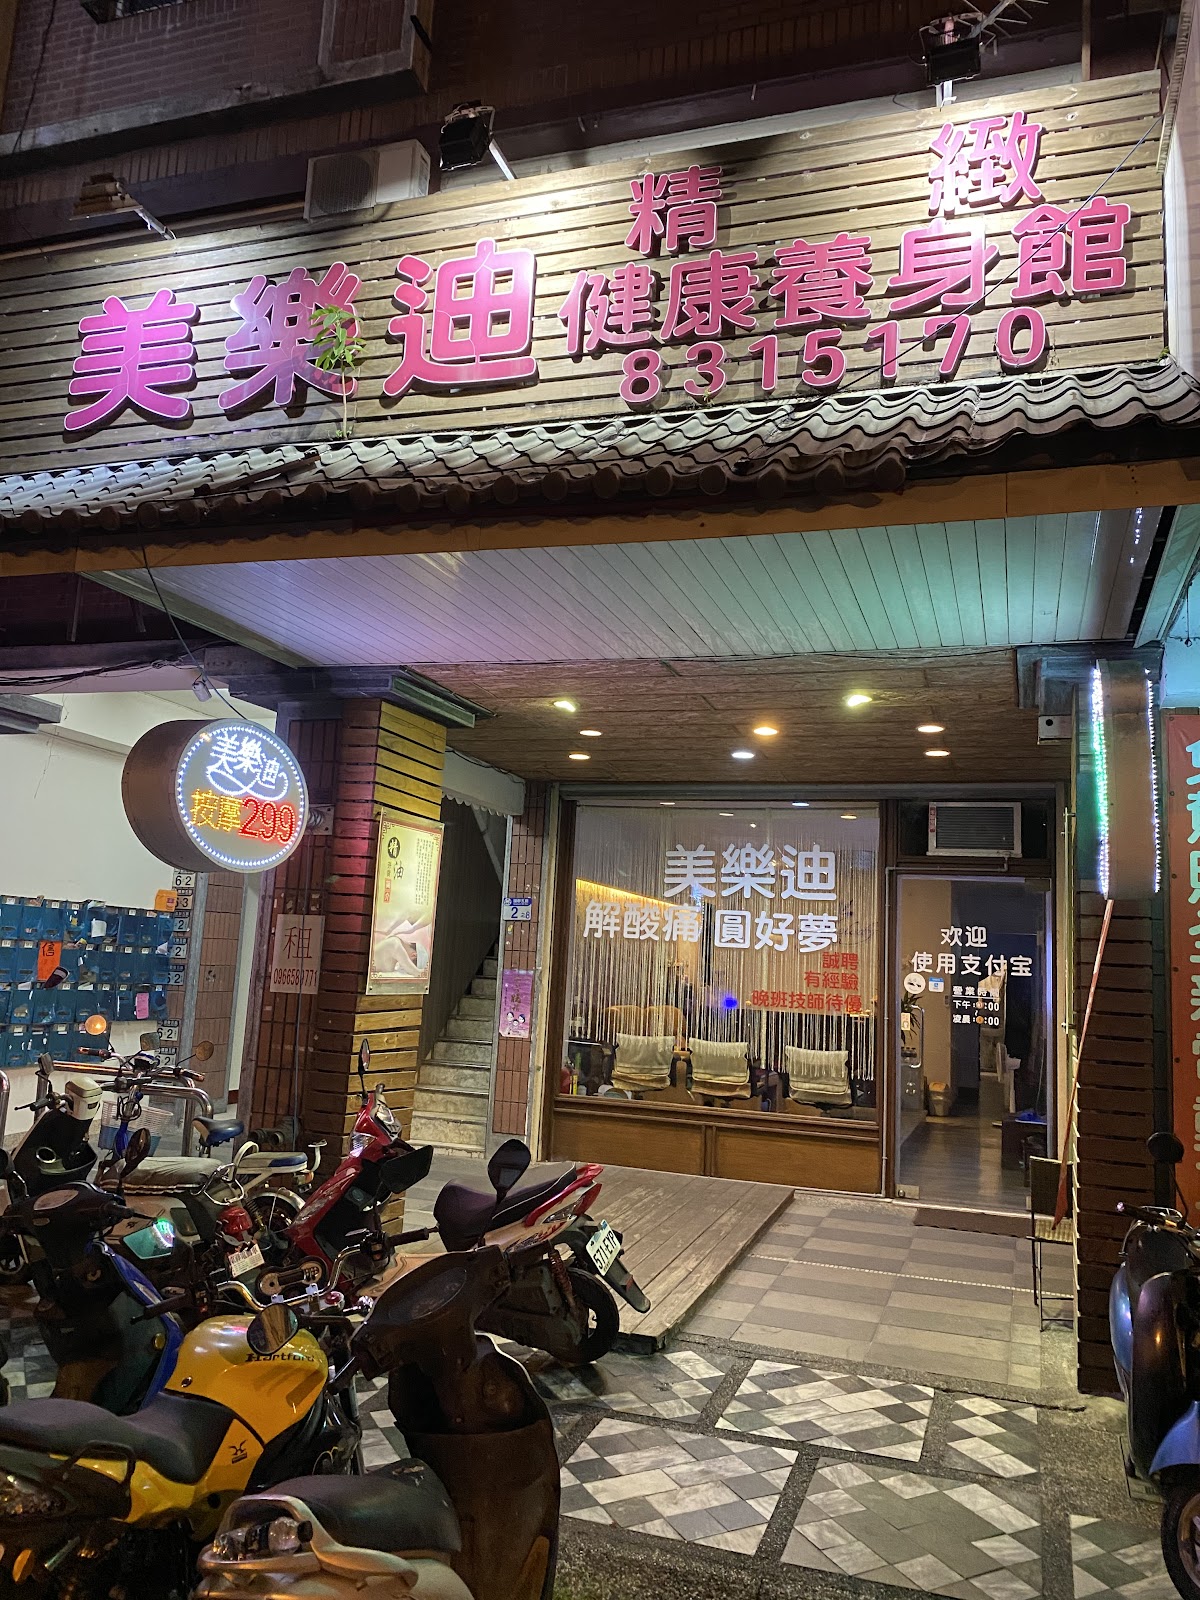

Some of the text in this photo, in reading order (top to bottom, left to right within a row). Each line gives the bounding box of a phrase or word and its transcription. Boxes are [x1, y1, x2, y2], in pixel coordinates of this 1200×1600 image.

[625, 110, 1043, 256] 精 緻
[557, 196, 1132, 357] 健康養身館
[63, 236, 538, 432] 美樂迪
[620, 306, 1049, 404] 8315170
[206, 730, 281, 790] 美樂迪
[663, 842, 838, 901] 美樂迪
[283, 926, 313, 960] 租
[583, 899, 838, 953] 解酸痛 圓好夢
[940, 925, 988, 948] 欢迎
[803, 971, 859, 991] 有經驗
[822, 951, 859, 970] 誠聘
[911, 951, 1033, 977] 使用支付宝
[751, 990, 863, 1014] 晚班技師待優
